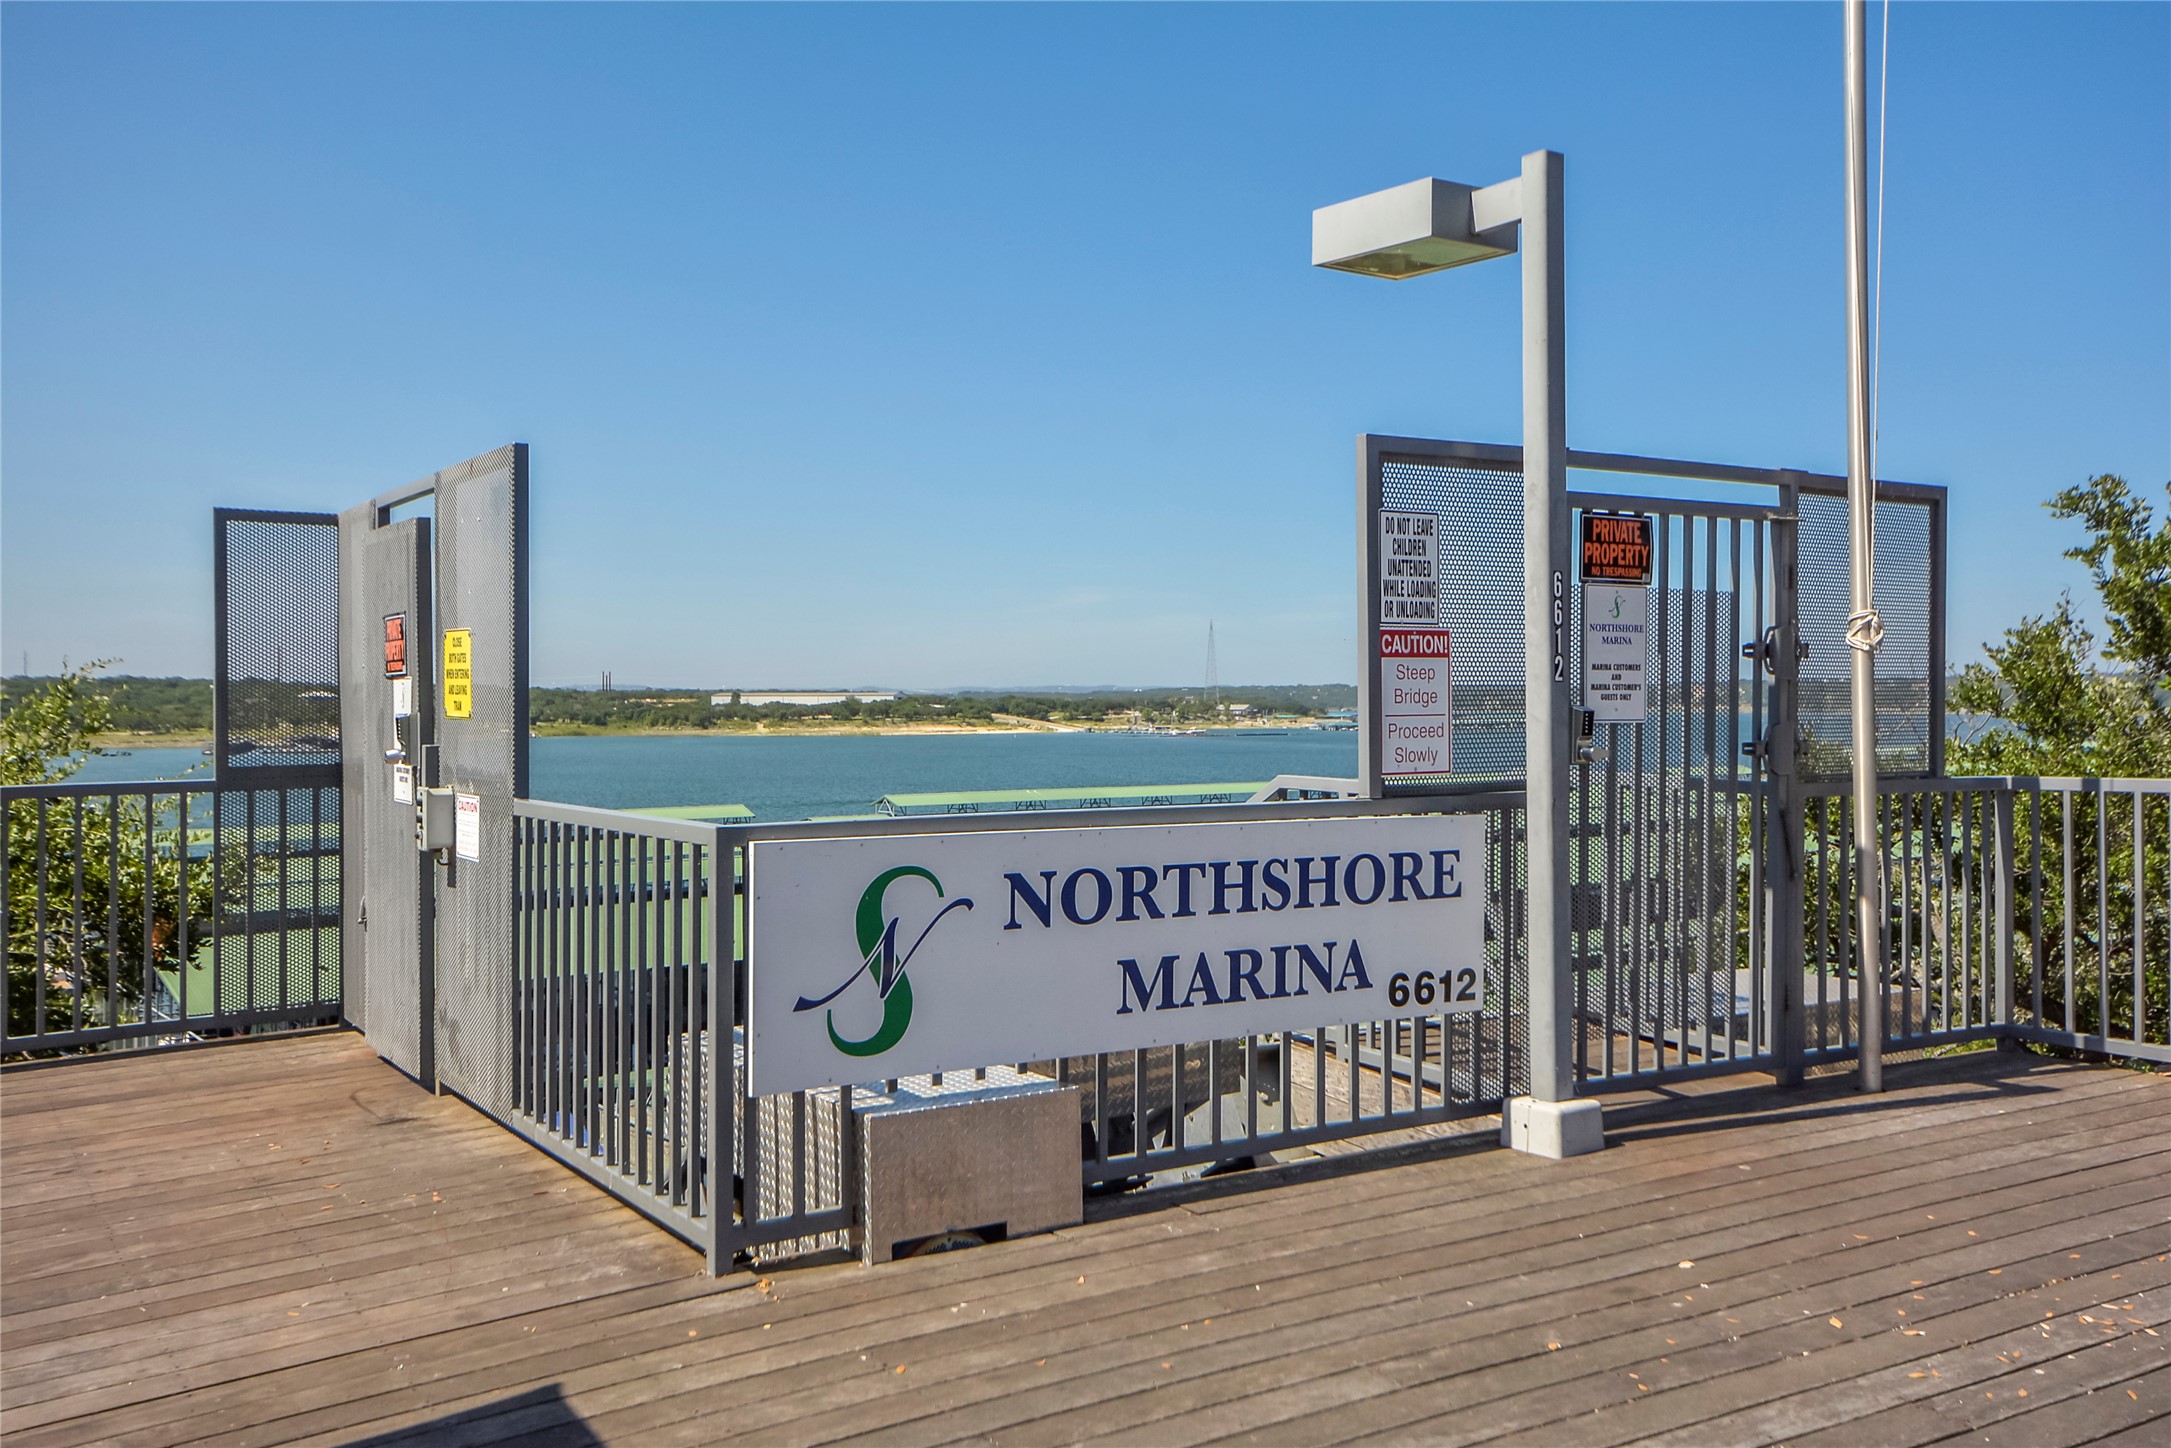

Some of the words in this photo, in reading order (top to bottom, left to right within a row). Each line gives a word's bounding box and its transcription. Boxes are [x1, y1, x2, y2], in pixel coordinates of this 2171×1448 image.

[1385, 516, 1395, 534] DO
[1397, 517, 1411, 535] NOT
[1412, 518, 1434, 536] LEAVE
[1592, 518, 1642, 543] PRIVATE
[1392, 537, 1427, 557] CHILDREN
[1584, 541, 1649, 567] PROPERTY
[1387, 558, 1432, 577] UNATTENDED
[1591, 566, 1601, 577] NO
[1602, 566, 1642, 578] TRESPASSING
[1382, 579, 1405, 598] WHILE
[1406, 580, 1437, 598] LOADING
[1384, 600, 1394, 618] OR
[1396, 600, 1435, 619] UNLOADING
[1589, 623, 1644, 634] NORTHSHORE
[1381, 634, 1448, 654] CAUTION!
[1601, 636, 1632, 645] MARINA
[1396, 664, 1436, 683] Steep
[1591, 663, 1612, 671] MARINA
[1613, 663, 1641, 672] CUSTOMERS
[1611, 673, 1622, 681] AND
[1394, 687, 1438, 708] Bridge
[1600, 693, 1619, 701] GUESTS
[1620, 693, 1632, 701] ONLY
[1388, 722, 1444, 739] Proceed
[1394, 746, 1438, 766] Slowly
[1002, 848, 1464, 931] NORTHSHORE
[1115, 938, 1375, 1016] MARINA
[1387, 967, 1478, 1008] 6612
